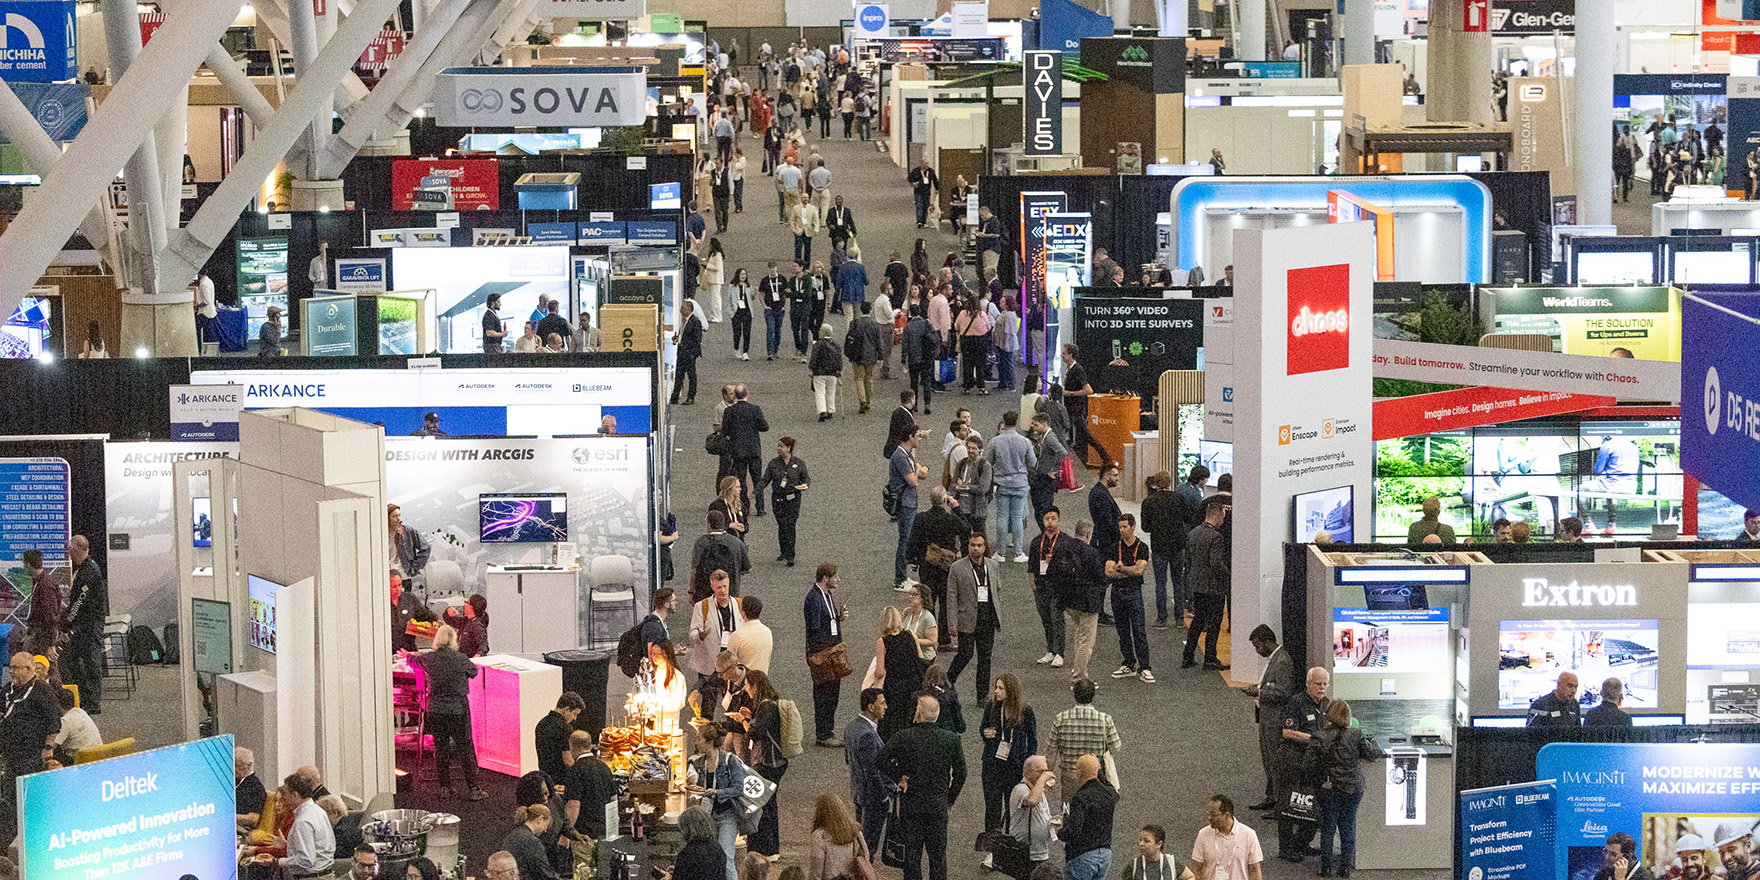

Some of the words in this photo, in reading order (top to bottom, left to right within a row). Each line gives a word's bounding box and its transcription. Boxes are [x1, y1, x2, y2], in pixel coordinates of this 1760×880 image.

[863, 13, 883, 23] inpro
[0, 49, 46, 60] ICHIHA
[16, 61, 46, 69] cement
[510, 87, 619, 114] SOVA
[1033, 54, 1054, 151] DAVIES
[582, 228, 602, 236] PAC
[1543, 296, 1613, 308] WorldTeams.
[1084, 307, 1111, 315] TURN
[1113, 306, 1135, 315] 360°
[1137, 307, 1168, 315] VIDEO
[1085, 320, 1108, 328] INTO
[1110, 319, 1123, 328] 3D
[1125, 319, 1147, 328] SITE
[1148, 319, 1193, 328] SURVEYS
[1292, 306, 1348, 336] chaos
[1585, 319, 1604, 328] THE
[1606, 318, 1654, 328] SOLUTION
[317, 323, 346, 333] Durable
[1394, 355, 1417, 366] Build
[1418, 358, 1465, 370] tomorrow.
[1469, 362, 1518, 374] Streamline
[1520, 368, 1540, 377] your
[1542, 367, 1583, 380] workflow
[1585, 371, 1604, 381] with
[1606, 372, 1639, 384] Chaos.
[247, 384, 325, 397] ARKANCE
[1424, 406, 1451, 420] Imagine
[1452, 404, 1470, 415] cities.
[1472, 401, 1494, 414] Design
[1495, 398, 1517, 409] homes.
[1519, 394, 1542, 406] Believe
[1727, 391, 1742, 432] D5
[1292, 430, 1318, 441] Enscape
[1335, 424, 1356, 434] Impact
[386, 450, 437, 461] DESIGN
[441, 449, 478, 461] WITH
[482, 449, 535, 460] ARCGIS
[595, 444, 629, 461] esri
[1289, 456, 1315, 466] Real-time
[1315, 451, 1341, 463] rendering
[124, 468, 158, 479] Design
[1278, 467, 1300, 478] building
[1300, 464, 1334, 477] performance
[1335, 460, 1355, 469] metrics.
[1521, 578, 1638, 607] Extron
[1643, 766, 1743, 778] MODERNIZE
[101, 771, 158, 802] Deltek
[1643, 782, 1726, 794] MAXIMIZE
[1290, 791, 1314, 806] FHC
[1524, 793, 1549, 802] BLUEBEAM
[48, 816, 137, 851] AI-Powered
[139, 801, 215, 830] Innovation
[1469, 820, 1507, 832] Transform
[1580, 820, 1608, 834] Leica
[1470, 833, 1495, 845] Project
[1496, 829, 1533, 840] Efficiency
[54, 848, 101, 871] Boosting
[102, 834, 165, 859] Productivity
[167, 829, 182, 845] for
[183, 825, 210, 841] More
[1469, 847, 1484, 857] with
[1484, 844, 1523, 854] Bluebeam
[83, 866, 110, 880] Than
[111, 861, 131, 874] 12K
[132, 855, 154, 870] A&E
[155, 849, 184, 865] Firms
[1487, 864, 1515, 873] Streamline
